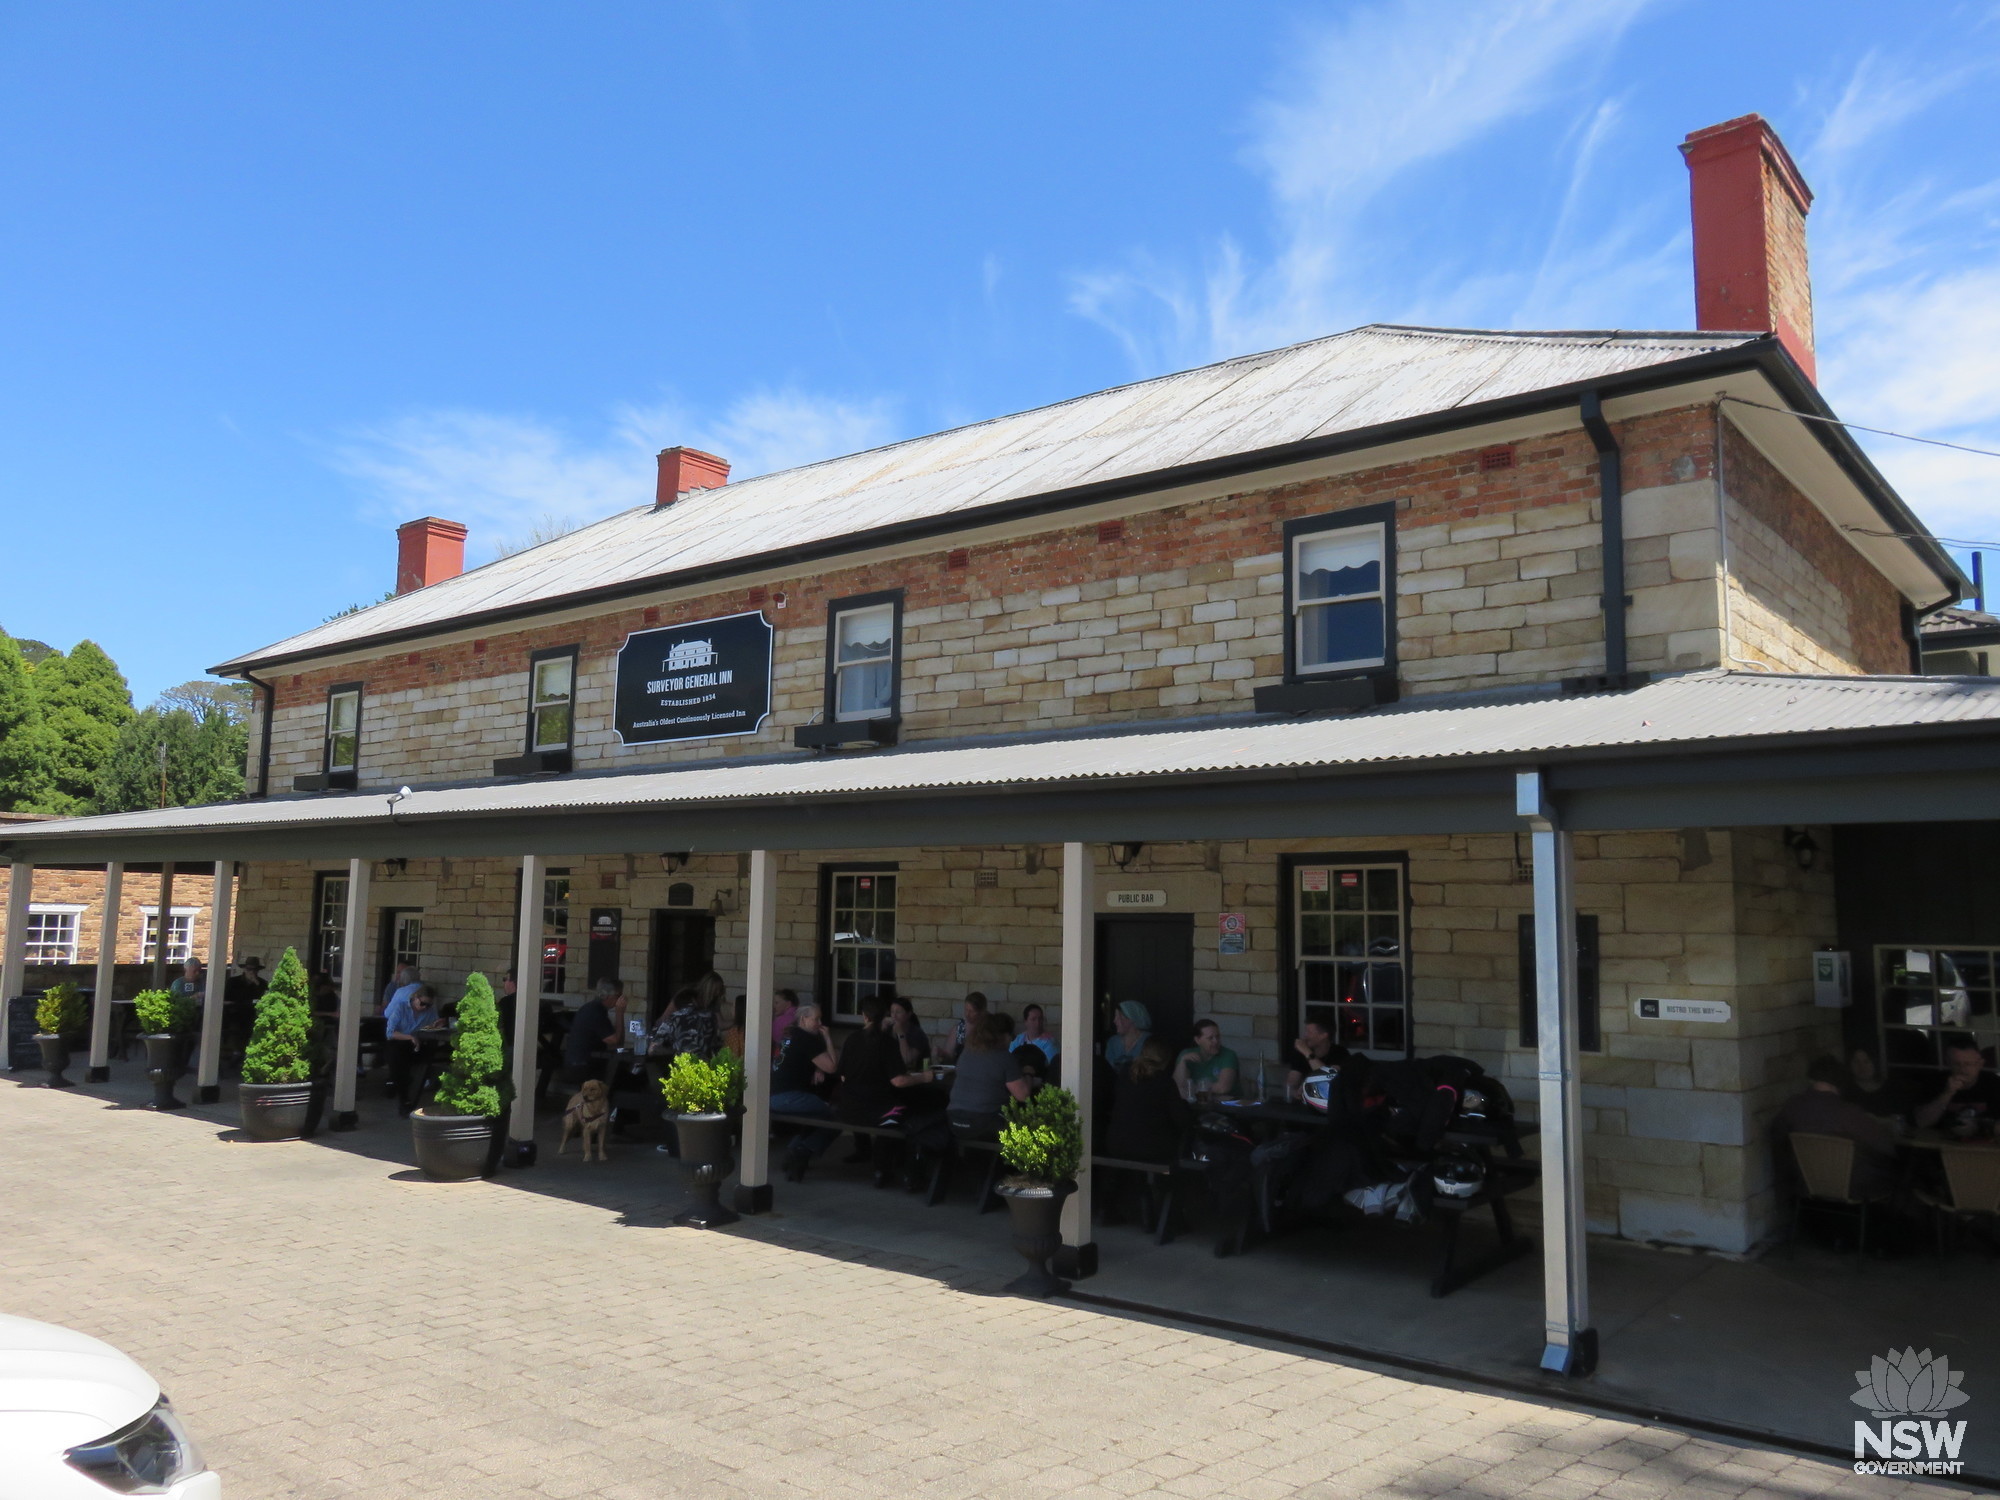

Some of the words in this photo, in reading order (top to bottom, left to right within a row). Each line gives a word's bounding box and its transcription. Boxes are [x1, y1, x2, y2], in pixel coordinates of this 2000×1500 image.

[647, 677, 684, 694] SURVEYOR
[685, 672, 718, 689] GENERAL
[719, 670, 733, 684] INN
[660, 697, 701, 706] ESTABLISHED
[702, 693, 716, 702] 1834
[632, 719, 659, 728] Australia's
[659, 717, 675, 726] Oldest
[676, 713, 710, 724] Continuously
[711, 710, 735, 720] Licensed
[1118, 894, 1140, 903] PUBLIC
[1141, 893, 1154, 903] BAR
[1667, 1006, 1687, 1014] BISTRO
[1688, 1006, 1702, 1014] THIS
